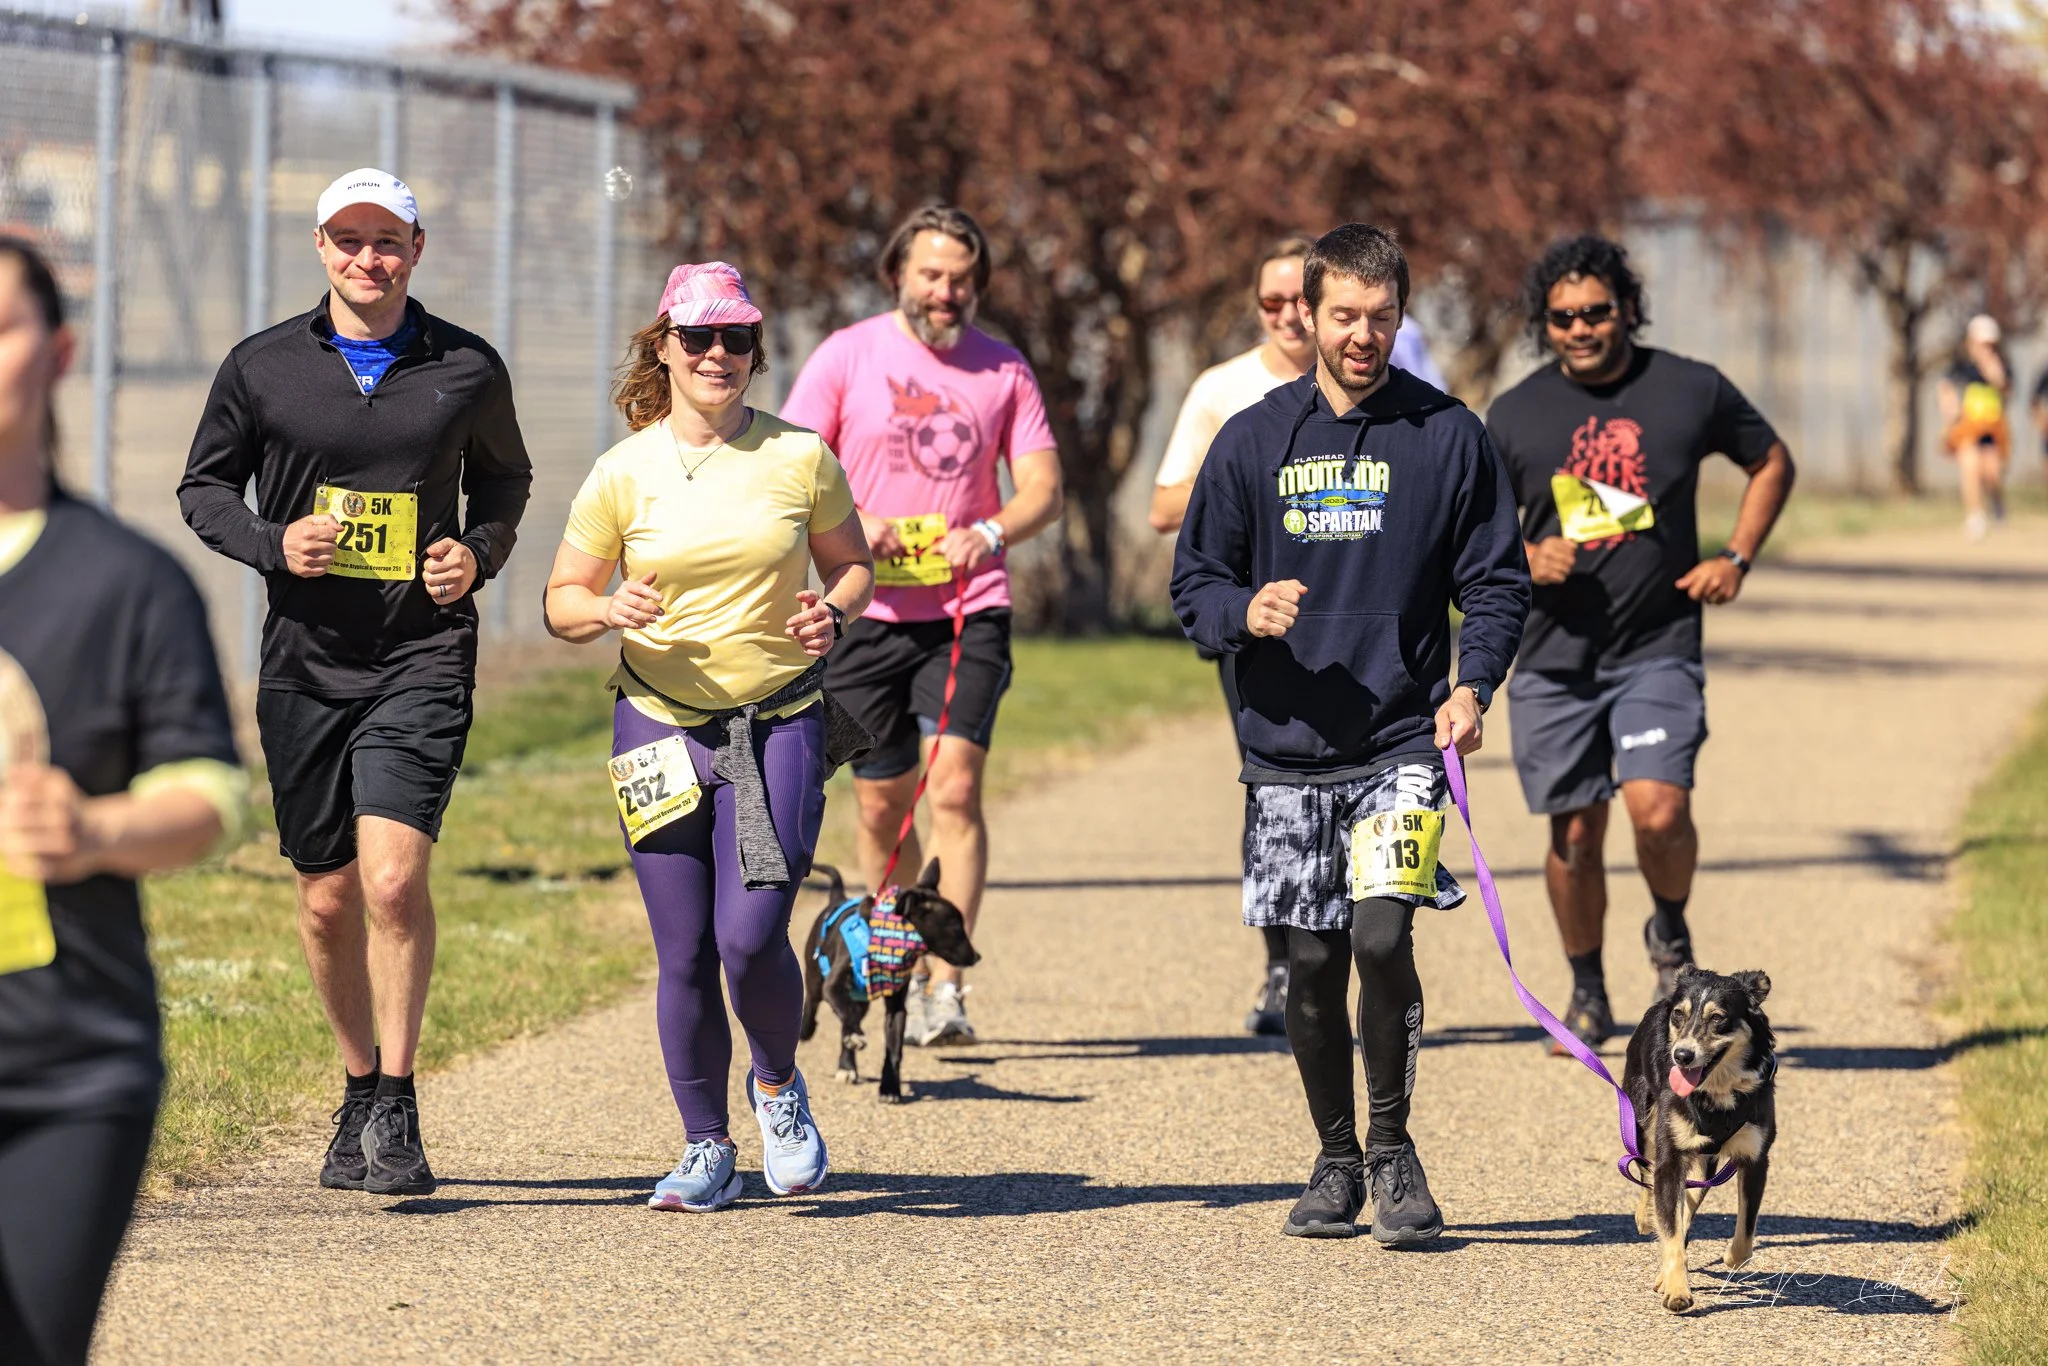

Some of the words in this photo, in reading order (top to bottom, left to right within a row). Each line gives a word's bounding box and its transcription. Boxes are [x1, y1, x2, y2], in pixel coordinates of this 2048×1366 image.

[347, 182, 380, 190] KIPRUN
[1294, 454, 1345, 464] FLATHEAD
[371, 498, 392, 515] 5K
[1308, 510, 1381, 533] SPARTAN
[338, 520, 387, 554] 251
[618, 771, 671, 817] 252
[661, 803, 682, 816] Beverage
[682, 798, 692, 807] 252
[1402, 814, 1424, 832] 5K
[1376, 839, 1420, 870] 113
[1404, 1023, 1421, 1099] SPARTAN
